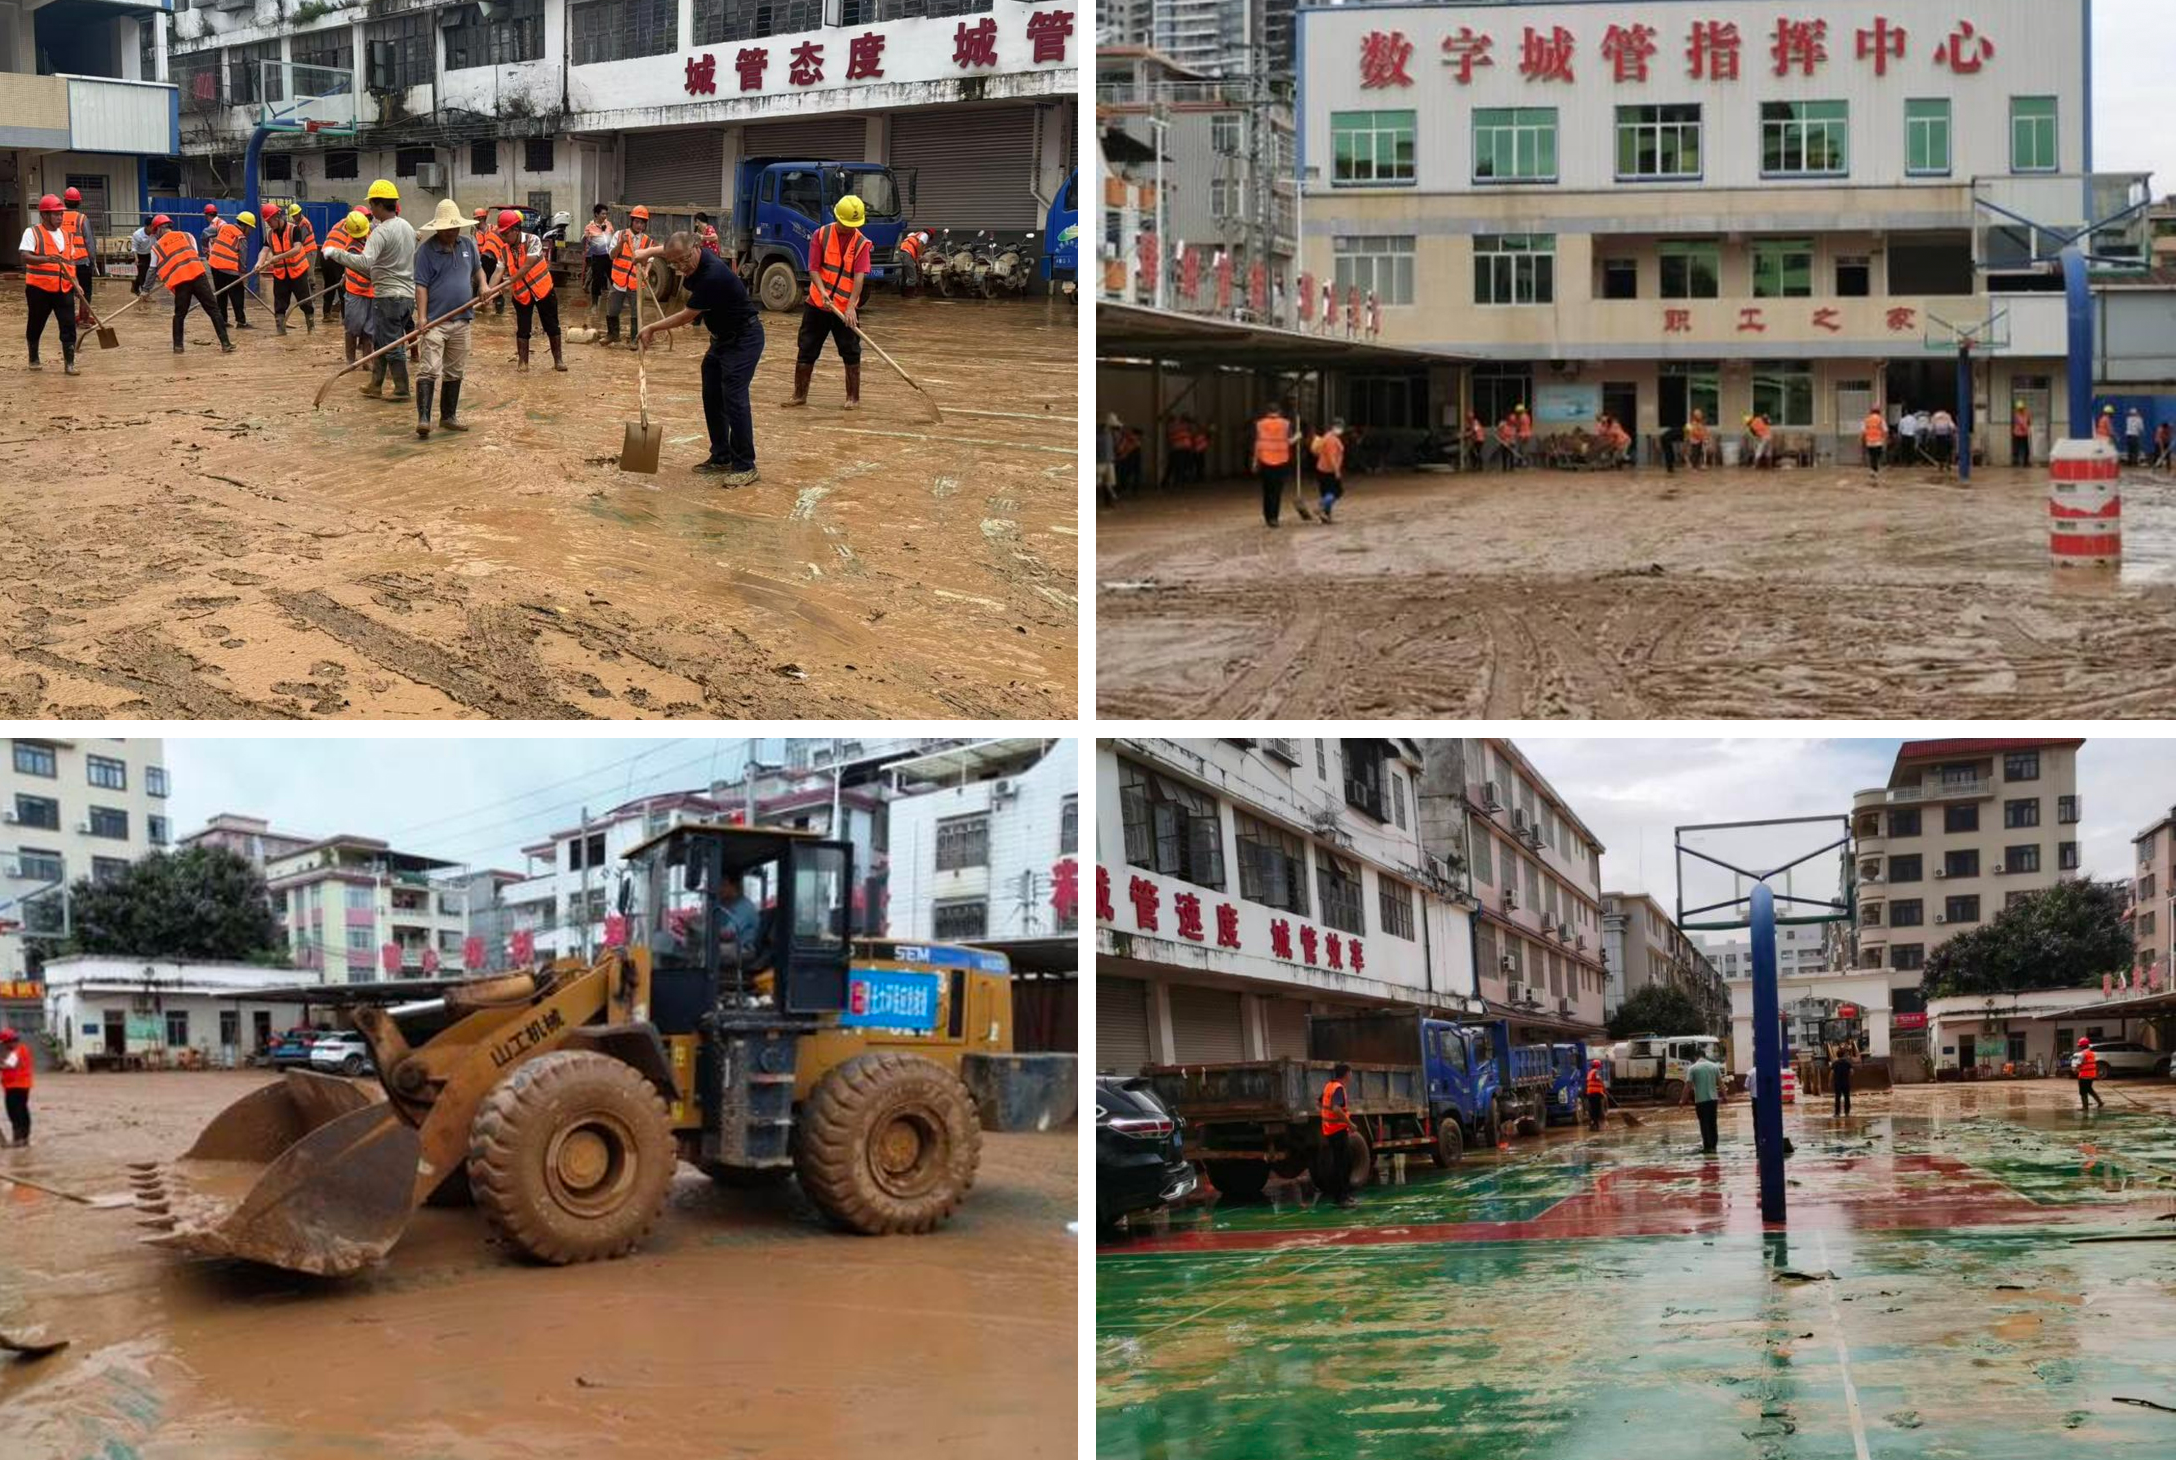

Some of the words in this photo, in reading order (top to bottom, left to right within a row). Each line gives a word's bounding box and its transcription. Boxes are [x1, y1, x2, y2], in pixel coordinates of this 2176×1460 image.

[685, 32, 885, 95] 城管态度
[952, 10, 1074, 68] 城管
[1359, 16, 1995, 89] 数字城管指挥中心
[894, 944, 931, 963] SEM
[490, 1008, 565, 1068] 山工机械
